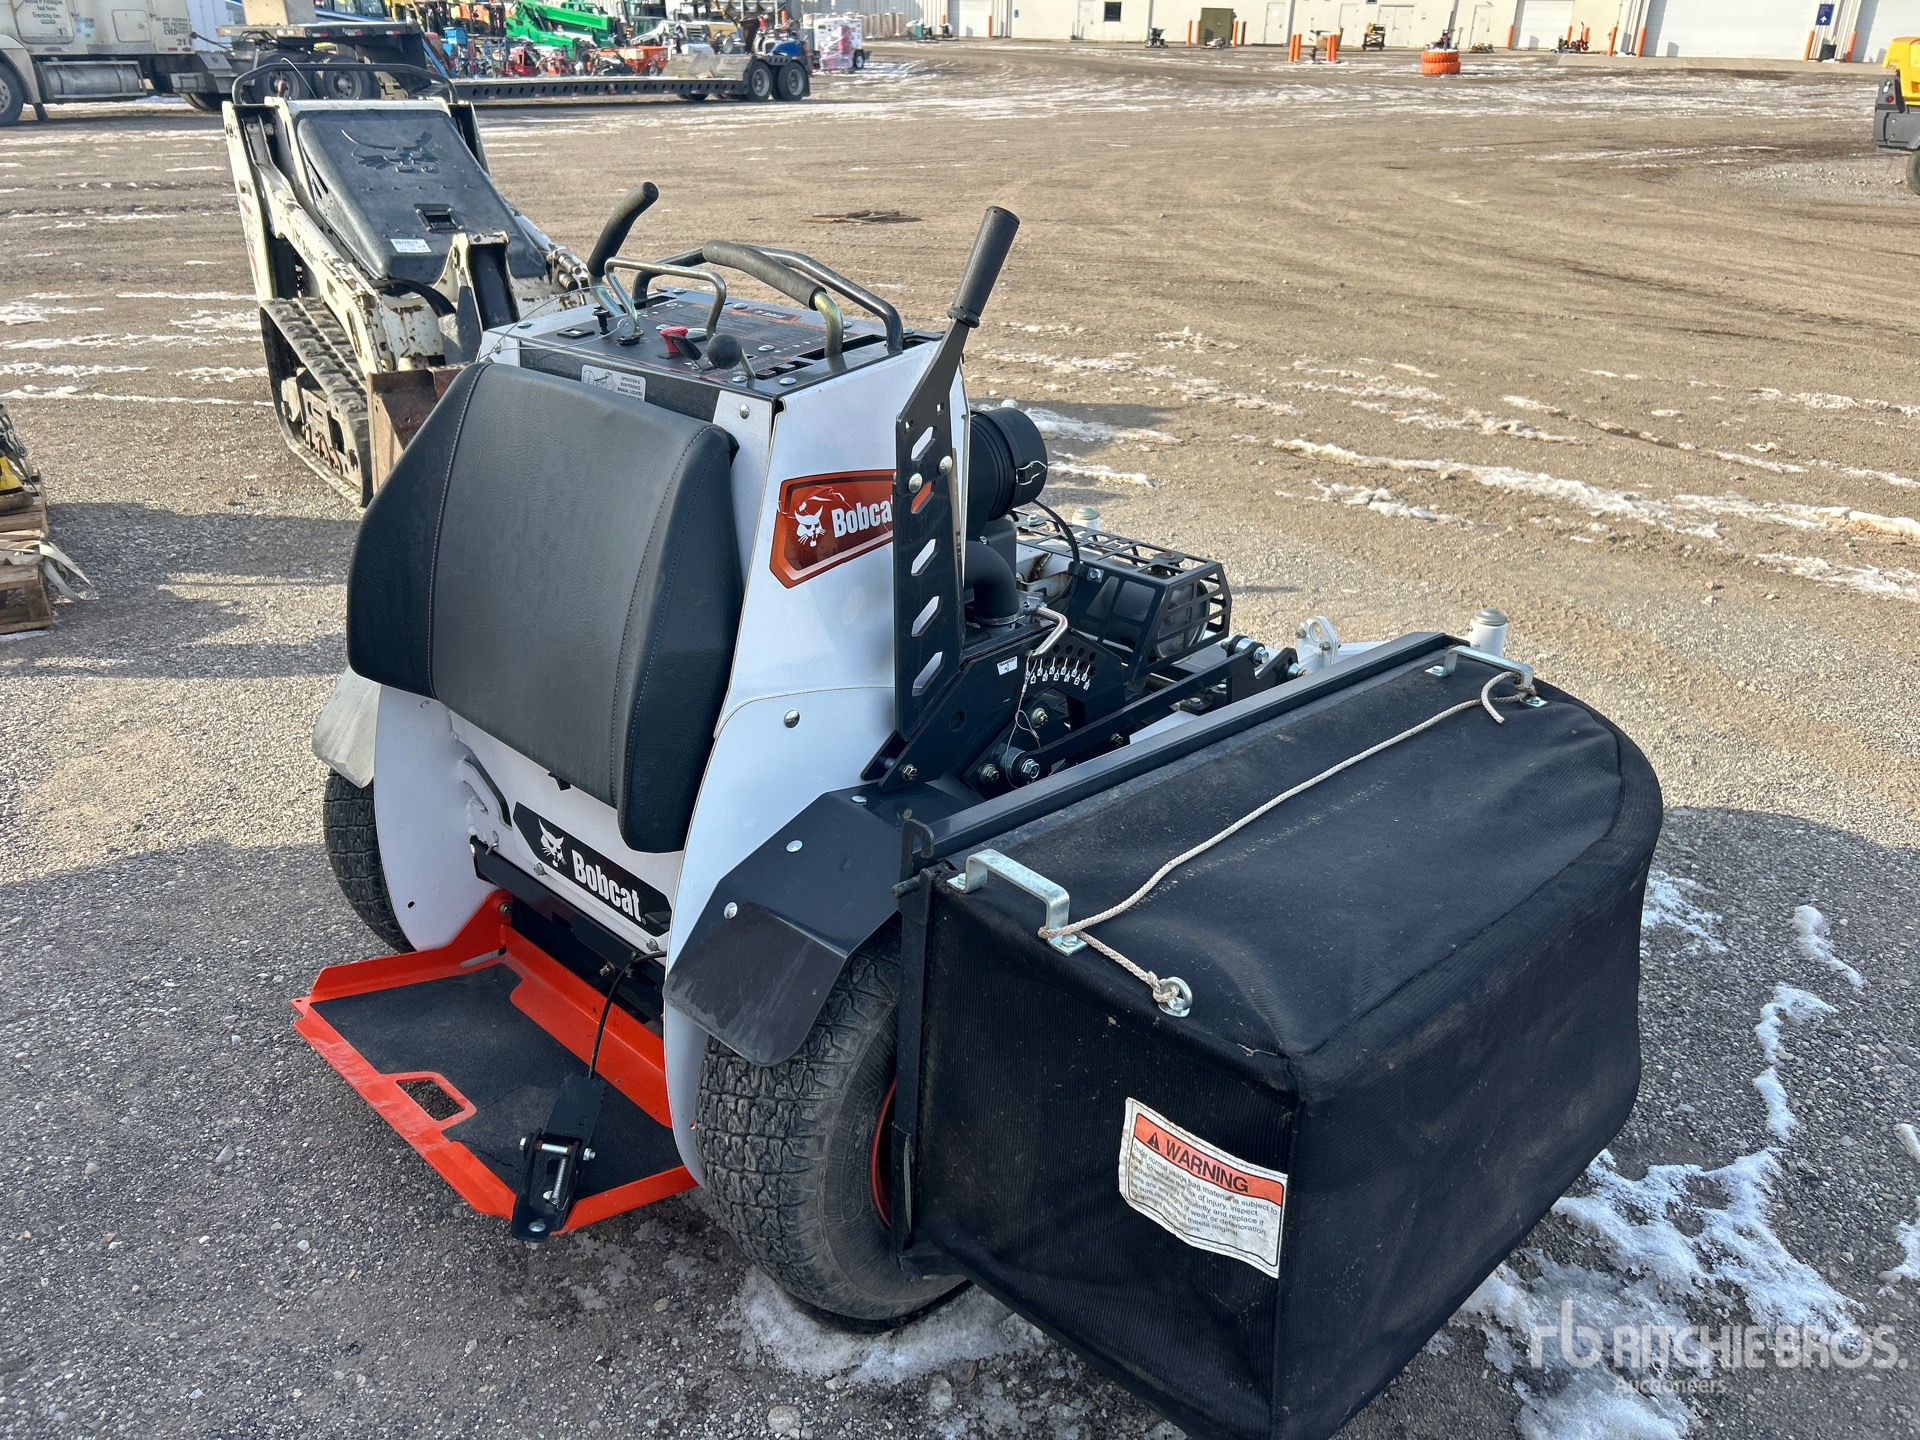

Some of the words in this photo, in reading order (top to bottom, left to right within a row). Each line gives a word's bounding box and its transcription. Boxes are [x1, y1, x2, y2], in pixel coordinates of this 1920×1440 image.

[831, 498, 893, 538] Bobca
[571, 849, 642, 923] Bobcat
[1146, 1162, 1154, 1172] To
[1175, 1181, 1186, 1190] the
[1198, 1193, 1205, 1203] of
[1206, 1196, 1228, 1211] injury.
[1230, 1204, 1259, 1217] Inspect
[1148, 1156, 1168, 1173] normal
[1168, 1168, 1187, 1184] usage
[1187, 1178, 1202, 1192] bag
[1202, 1186, 1231, 1202] material
[1233, 1197, 1240, 1205] is
[1241, 1198, 1269, 1212] subject
[1270, 1206, 1278, 1216] to
[1166, 1138, 1249, 1193] WARNING
[1138, 1185, 1154, 1196] sure
[1187, 1217, 1211, 1228] meets
[1211, 1222, 1239, 1237] original
[1145, 1180, 1157, 1190] are
[1190, 1209, 1209, 1220] wear
[1210, 1215, 1219, 1223] or
[1212, 1207, 1228, 1218] and
[1229, 1213, 1258, 1226] replace
